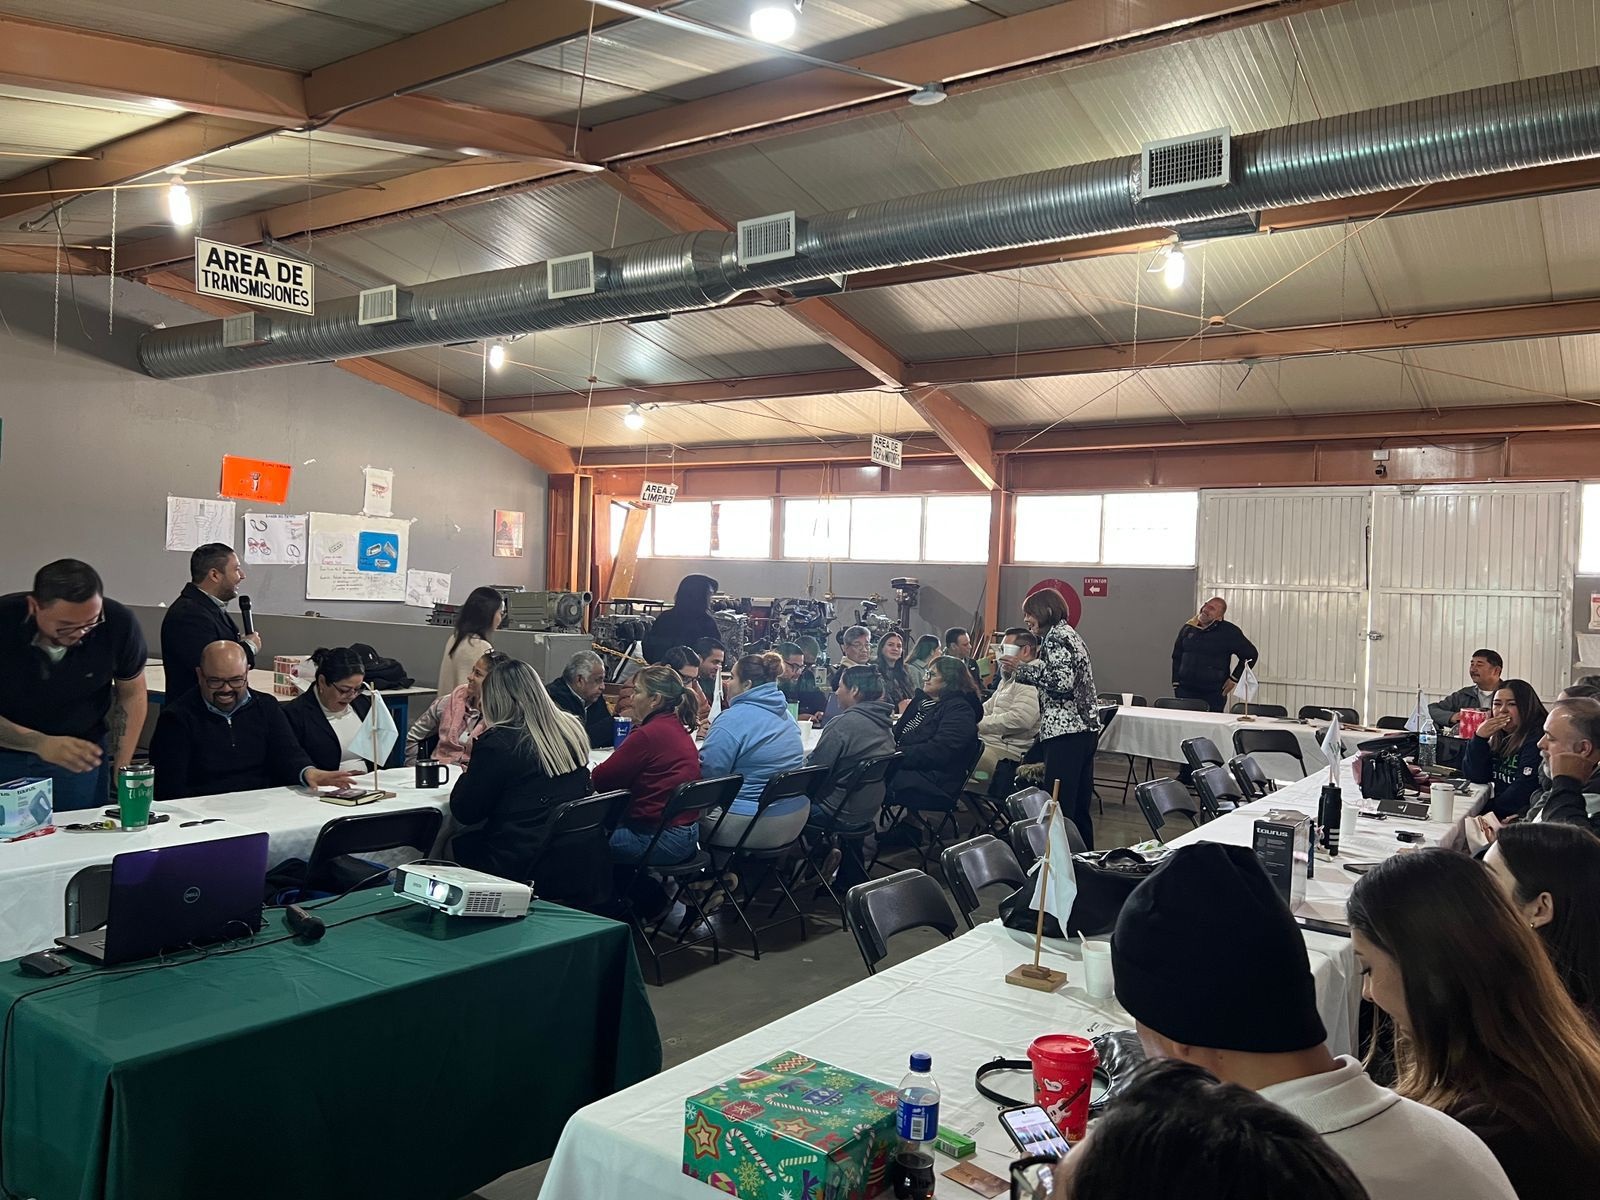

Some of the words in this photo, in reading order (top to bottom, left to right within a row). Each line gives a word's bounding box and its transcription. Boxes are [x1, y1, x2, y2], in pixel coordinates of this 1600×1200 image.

[205, 246, 270, 280] AREA
[277, 261, 304, 287] DE
[201, 269, 310, 308] TRANSMISIONES
[874, 436, 890, 450] AREA
[890, 442, 899, 453] DE
[645, 484, 667, 495] AREA
[1255, 827, 1289, 838] taurus
